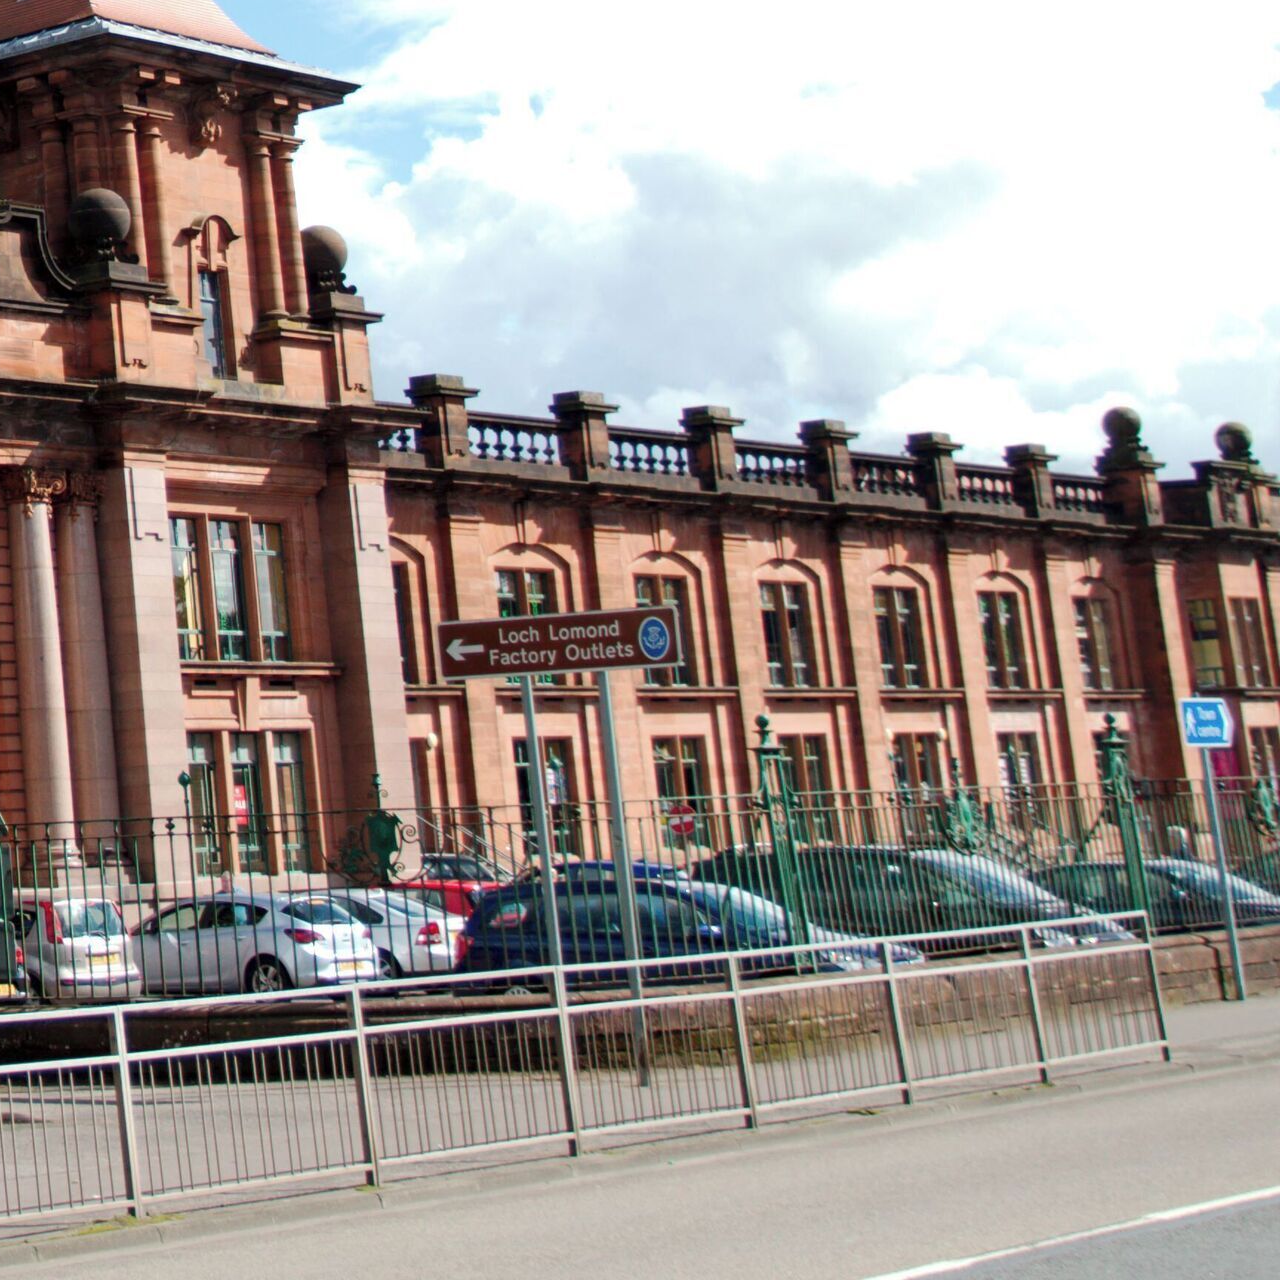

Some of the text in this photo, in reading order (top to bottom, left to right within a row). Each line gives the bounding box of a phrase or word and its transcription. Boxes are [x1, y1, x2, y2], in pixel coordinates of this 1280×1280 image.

[498, 620, 620, 644] Loch Lomond
[489, 641, 634, 666] Factory Outlets
[1197, 706, 1217, 720] Town
